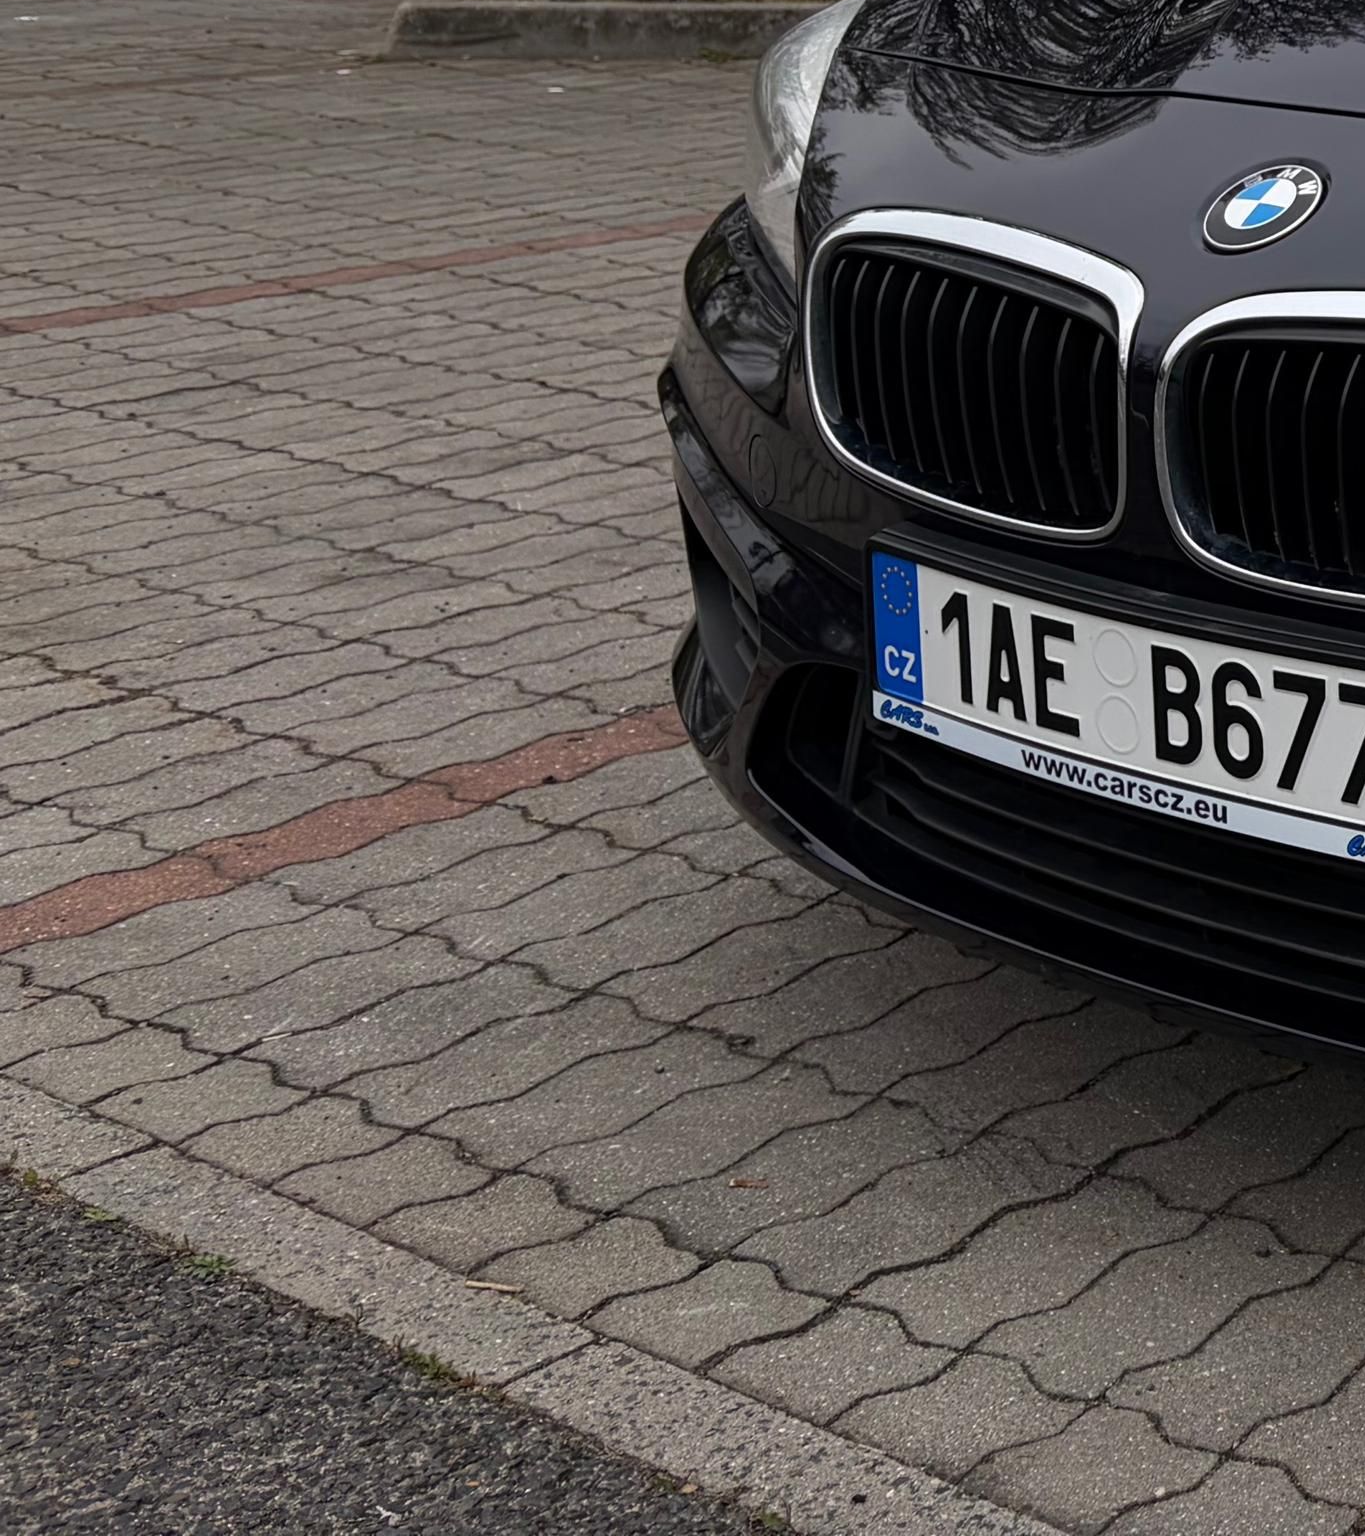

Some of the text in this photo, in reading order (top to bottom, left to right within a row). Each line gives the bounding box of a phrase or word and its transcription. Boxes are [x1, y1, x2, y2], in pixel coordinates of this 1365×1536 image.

[884, 645, 917, 684] CZ
[941, 591, 1081, 738] 1AE
[880, 699, 924, 729] CARS
[1021, 749, 1229, 824] www.carscz.eu
